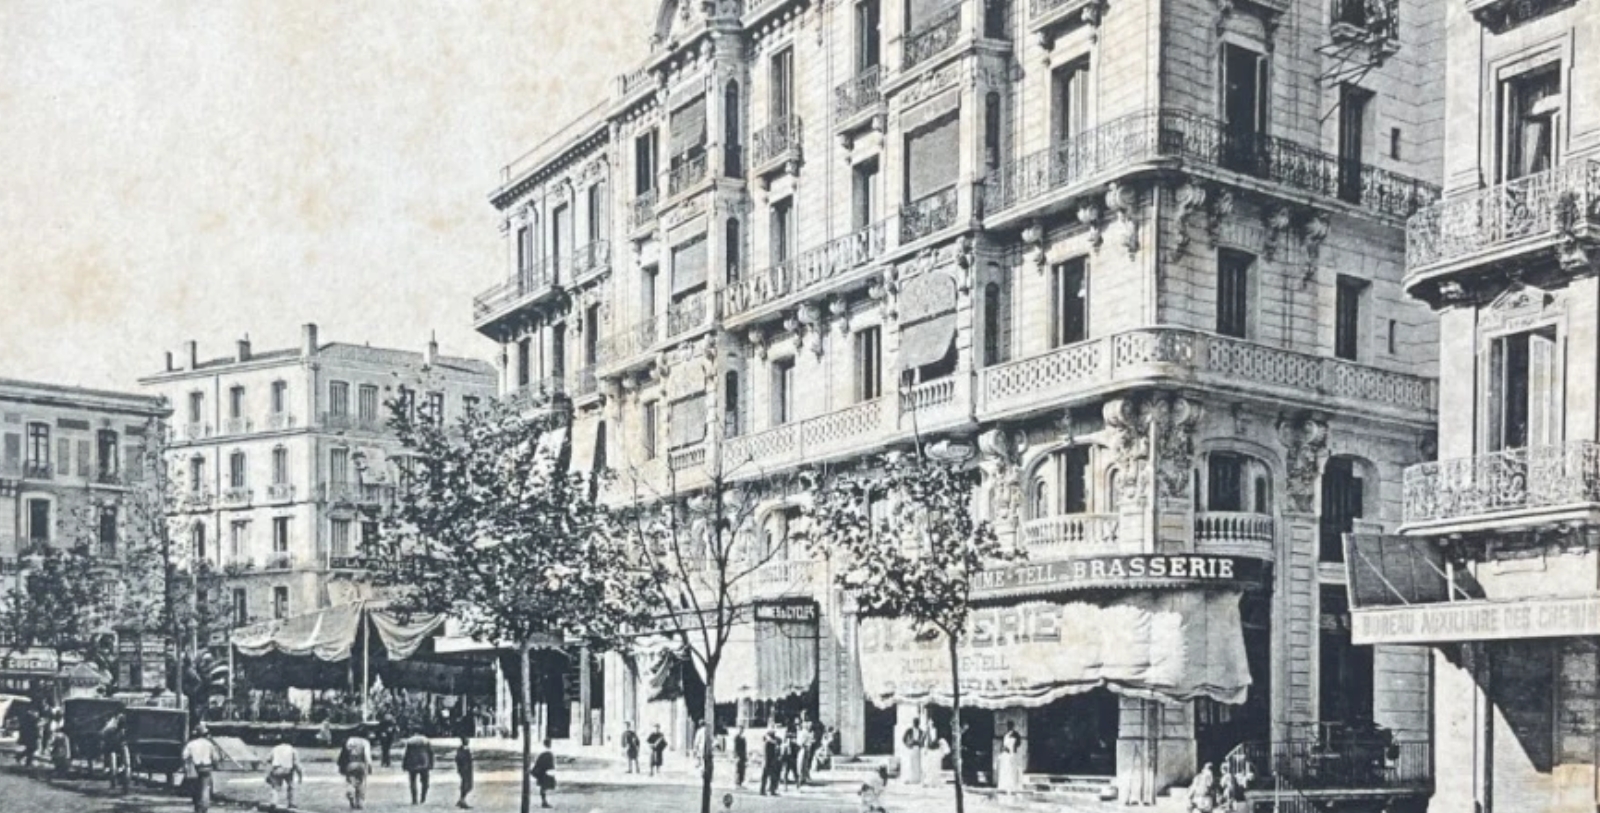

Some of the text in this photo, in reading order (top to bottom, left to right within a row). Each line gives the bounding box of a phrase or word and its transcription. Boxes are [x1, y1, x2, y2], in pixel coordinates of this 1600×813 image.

[1072, 556, 1235, 579] BRASSERIE
[862, 605, 1063, 653] BRERIE
[1362, 613, 1415, 637] BUREAU
[1420, 607, 1499, 635] AUXILIAIRE
[1503, 605, 1532, 630] DES
